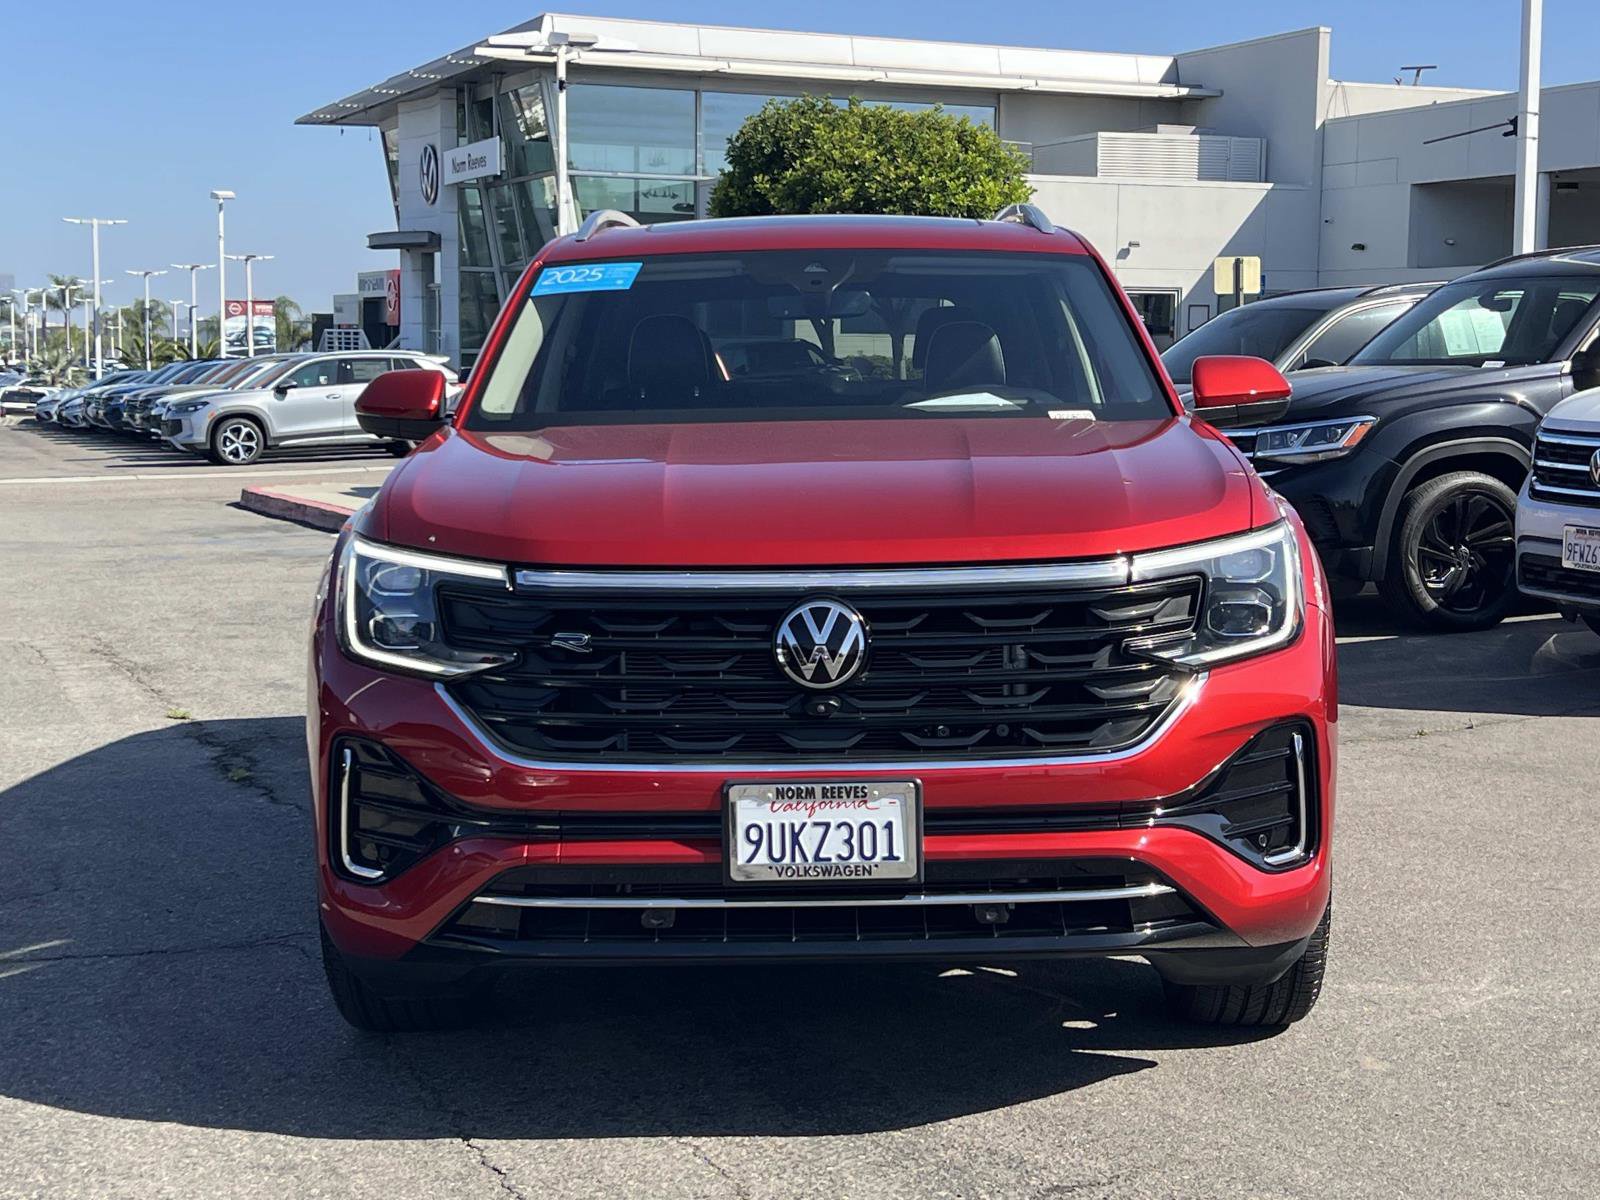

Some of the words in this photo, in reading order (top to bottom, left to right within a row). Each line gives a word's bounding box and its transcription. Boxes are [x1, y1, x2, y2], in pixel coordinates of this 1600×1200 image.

[452, 156, 466, 174] Norm
[468, 152, 487, 171] Reeves
[541, 267, 605, 286] 2025
[1566, 542, 1600, 565] 9FWZ6
[776, 786, 816, 800] NORM
[821, 786, 868, 800] REEVES
[769, 799, 880, 818] California
[744, 820, 902, 864] 9UKZ301
[774, 864, 873, 878] VOLKSWAGEN
